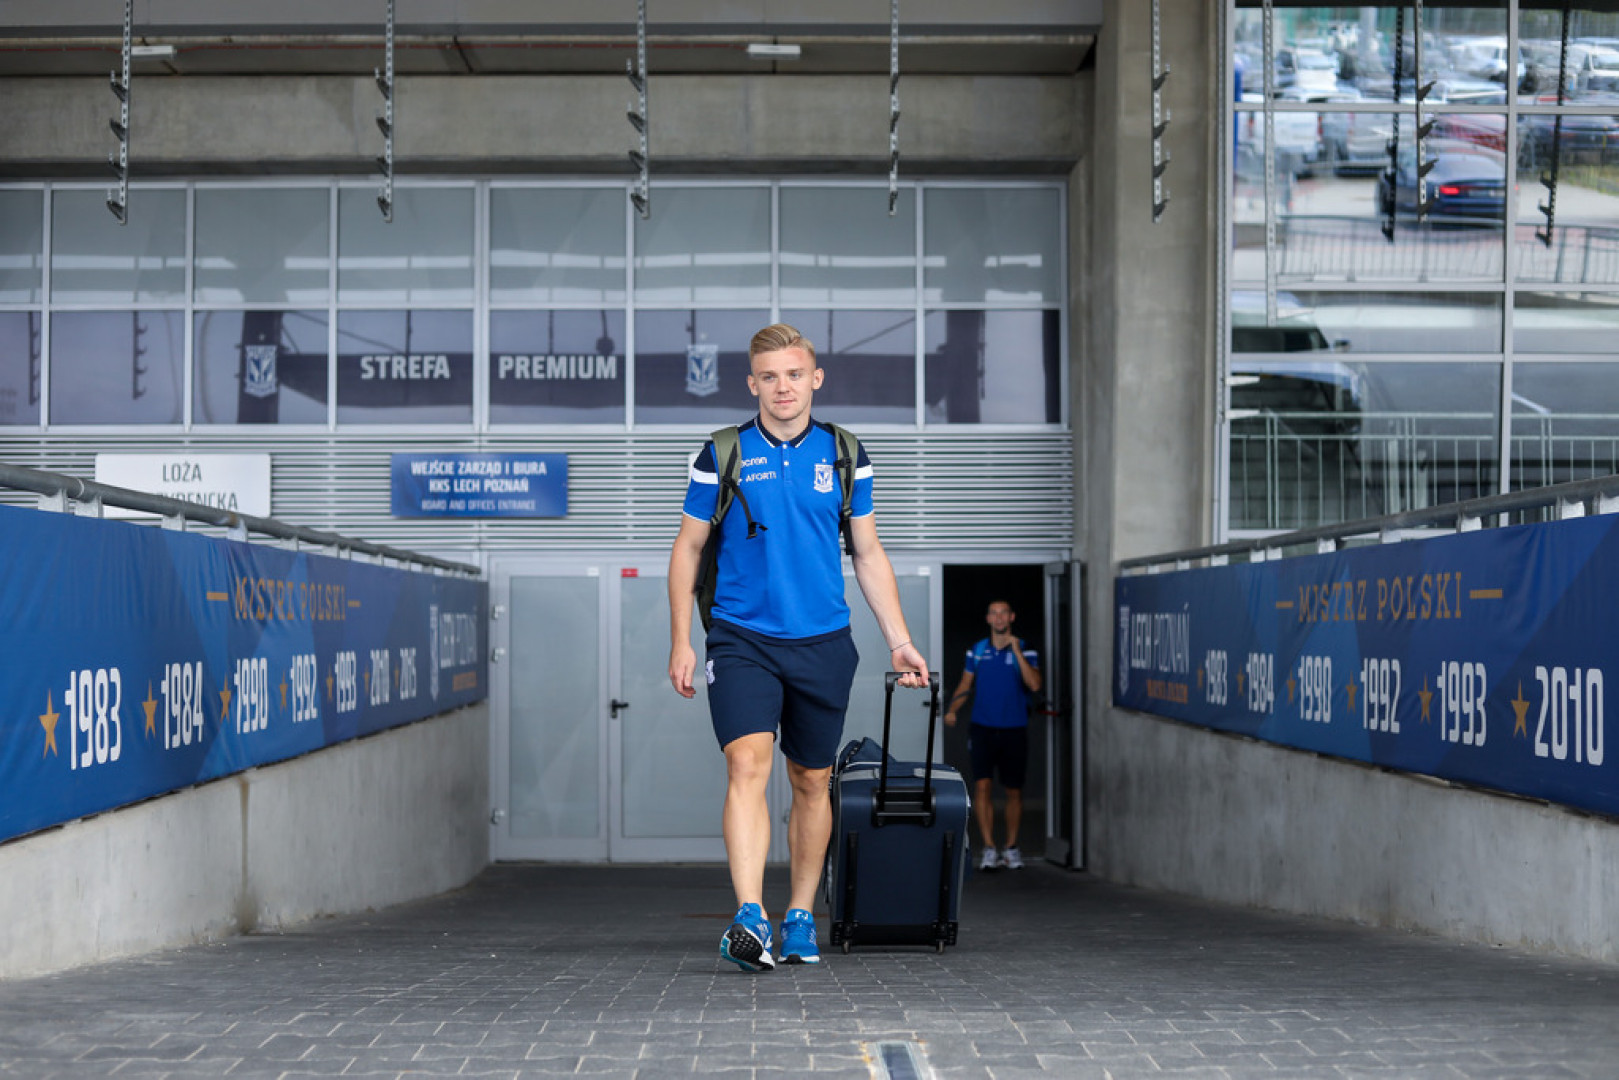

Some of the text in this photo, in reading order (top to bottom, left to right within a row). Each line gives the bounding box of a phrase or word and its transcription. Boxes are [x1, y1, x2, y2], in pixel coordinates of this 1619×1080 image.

[360, 355, 617, 380] STREFA PREMIUM
[162, 461, 202, 482] LOŻA
[410, 459, 455, 475] WEJŚCIE
[458, 461, 501, 477] ZARZĄD
[513, 461, 547, 475] BIURA
[453, 479, 480, 493] LECH
[483, 476, 529, 493] POZNAŃ
[235, 576, 346, 621] MISTRZ POLSKI
[1298, 571, 1462, 623] MISTRZ POLSKI
[65, 667, 122, 770] 1983
[161, 661, 204, 750] 1984
[234, 657, 268, 734] 1990
[291, 654, 318, 723] 1992
[335, 651, 357, 713] 1993
[1246, 653, 1274, 714] 1984
[1298, 655, 1332, 723] 1990
[1360, 657, 1401, 734] 1992
[1437, 661, 1487, 747] 1993
[1535, 665, 1604, 766] 2010
